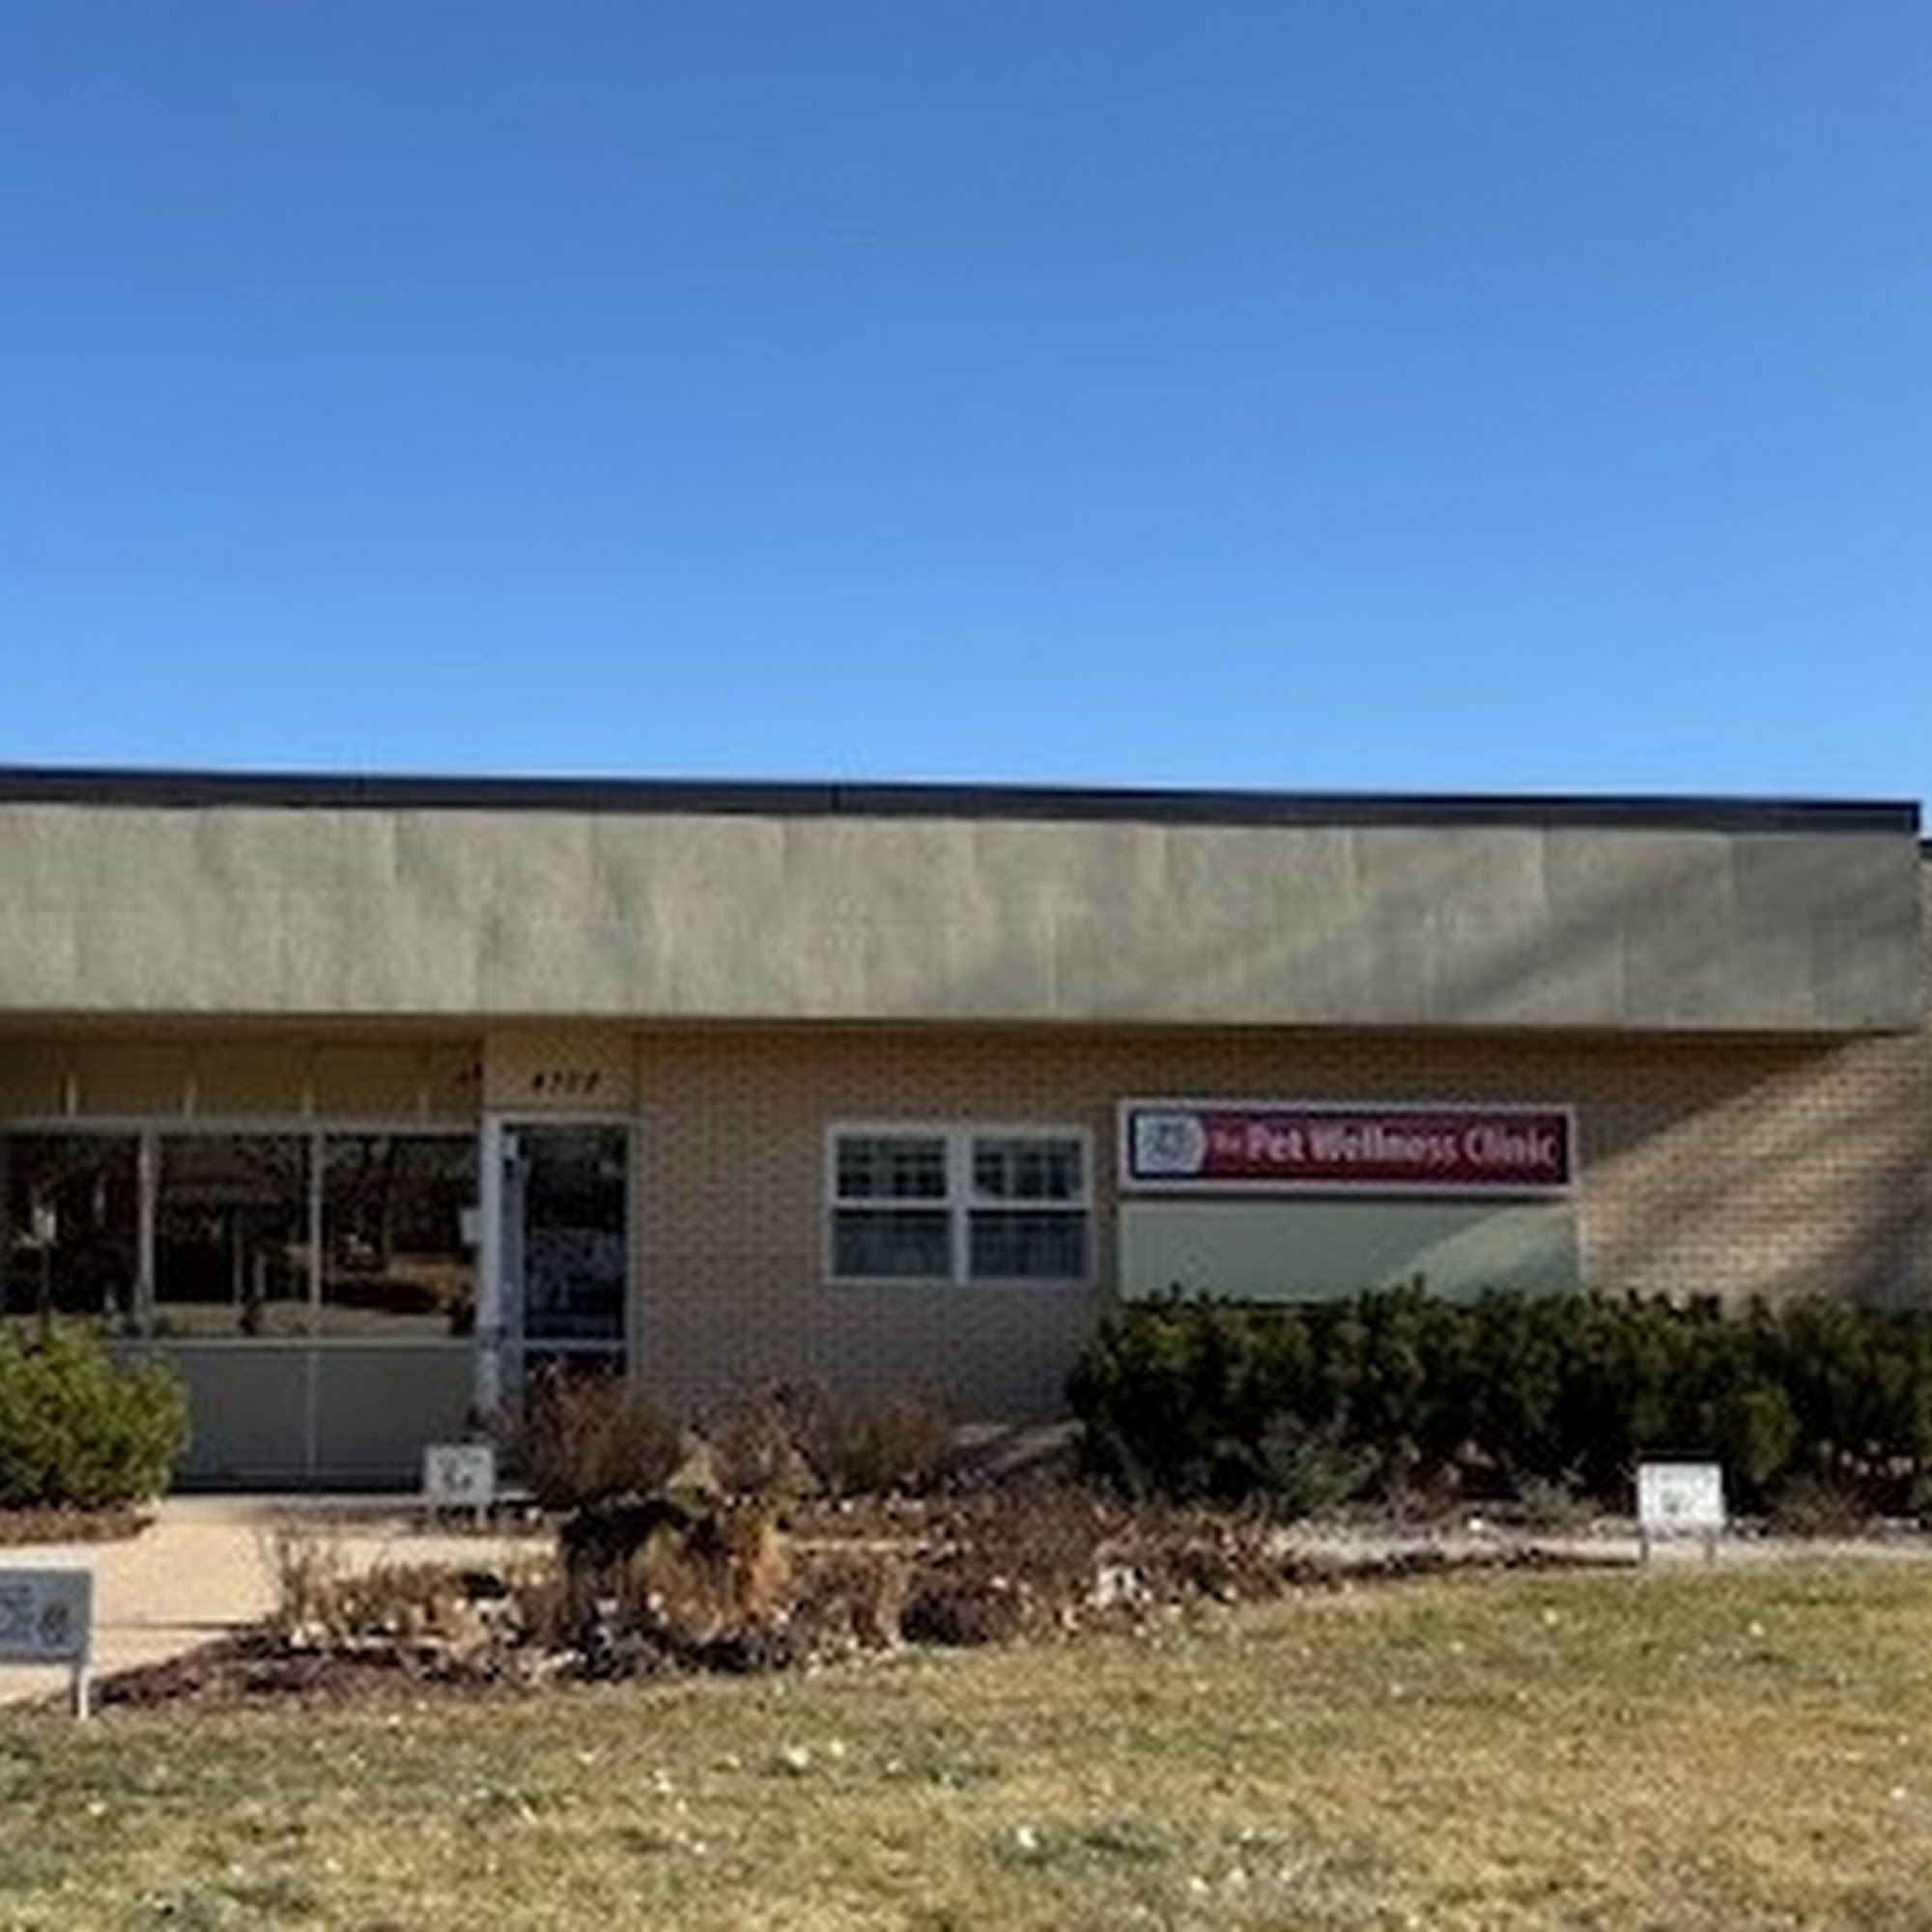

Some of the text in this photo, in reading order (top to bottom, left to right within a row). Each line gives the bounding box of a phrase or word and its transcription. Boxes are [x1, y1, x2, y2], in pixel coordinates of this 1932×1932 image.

[1246, 1122, 1303, 1162] Pet
[1309, 1122, 1460, 1165] Wellness
[1463, 1124, 1560, 1167] Clinic
